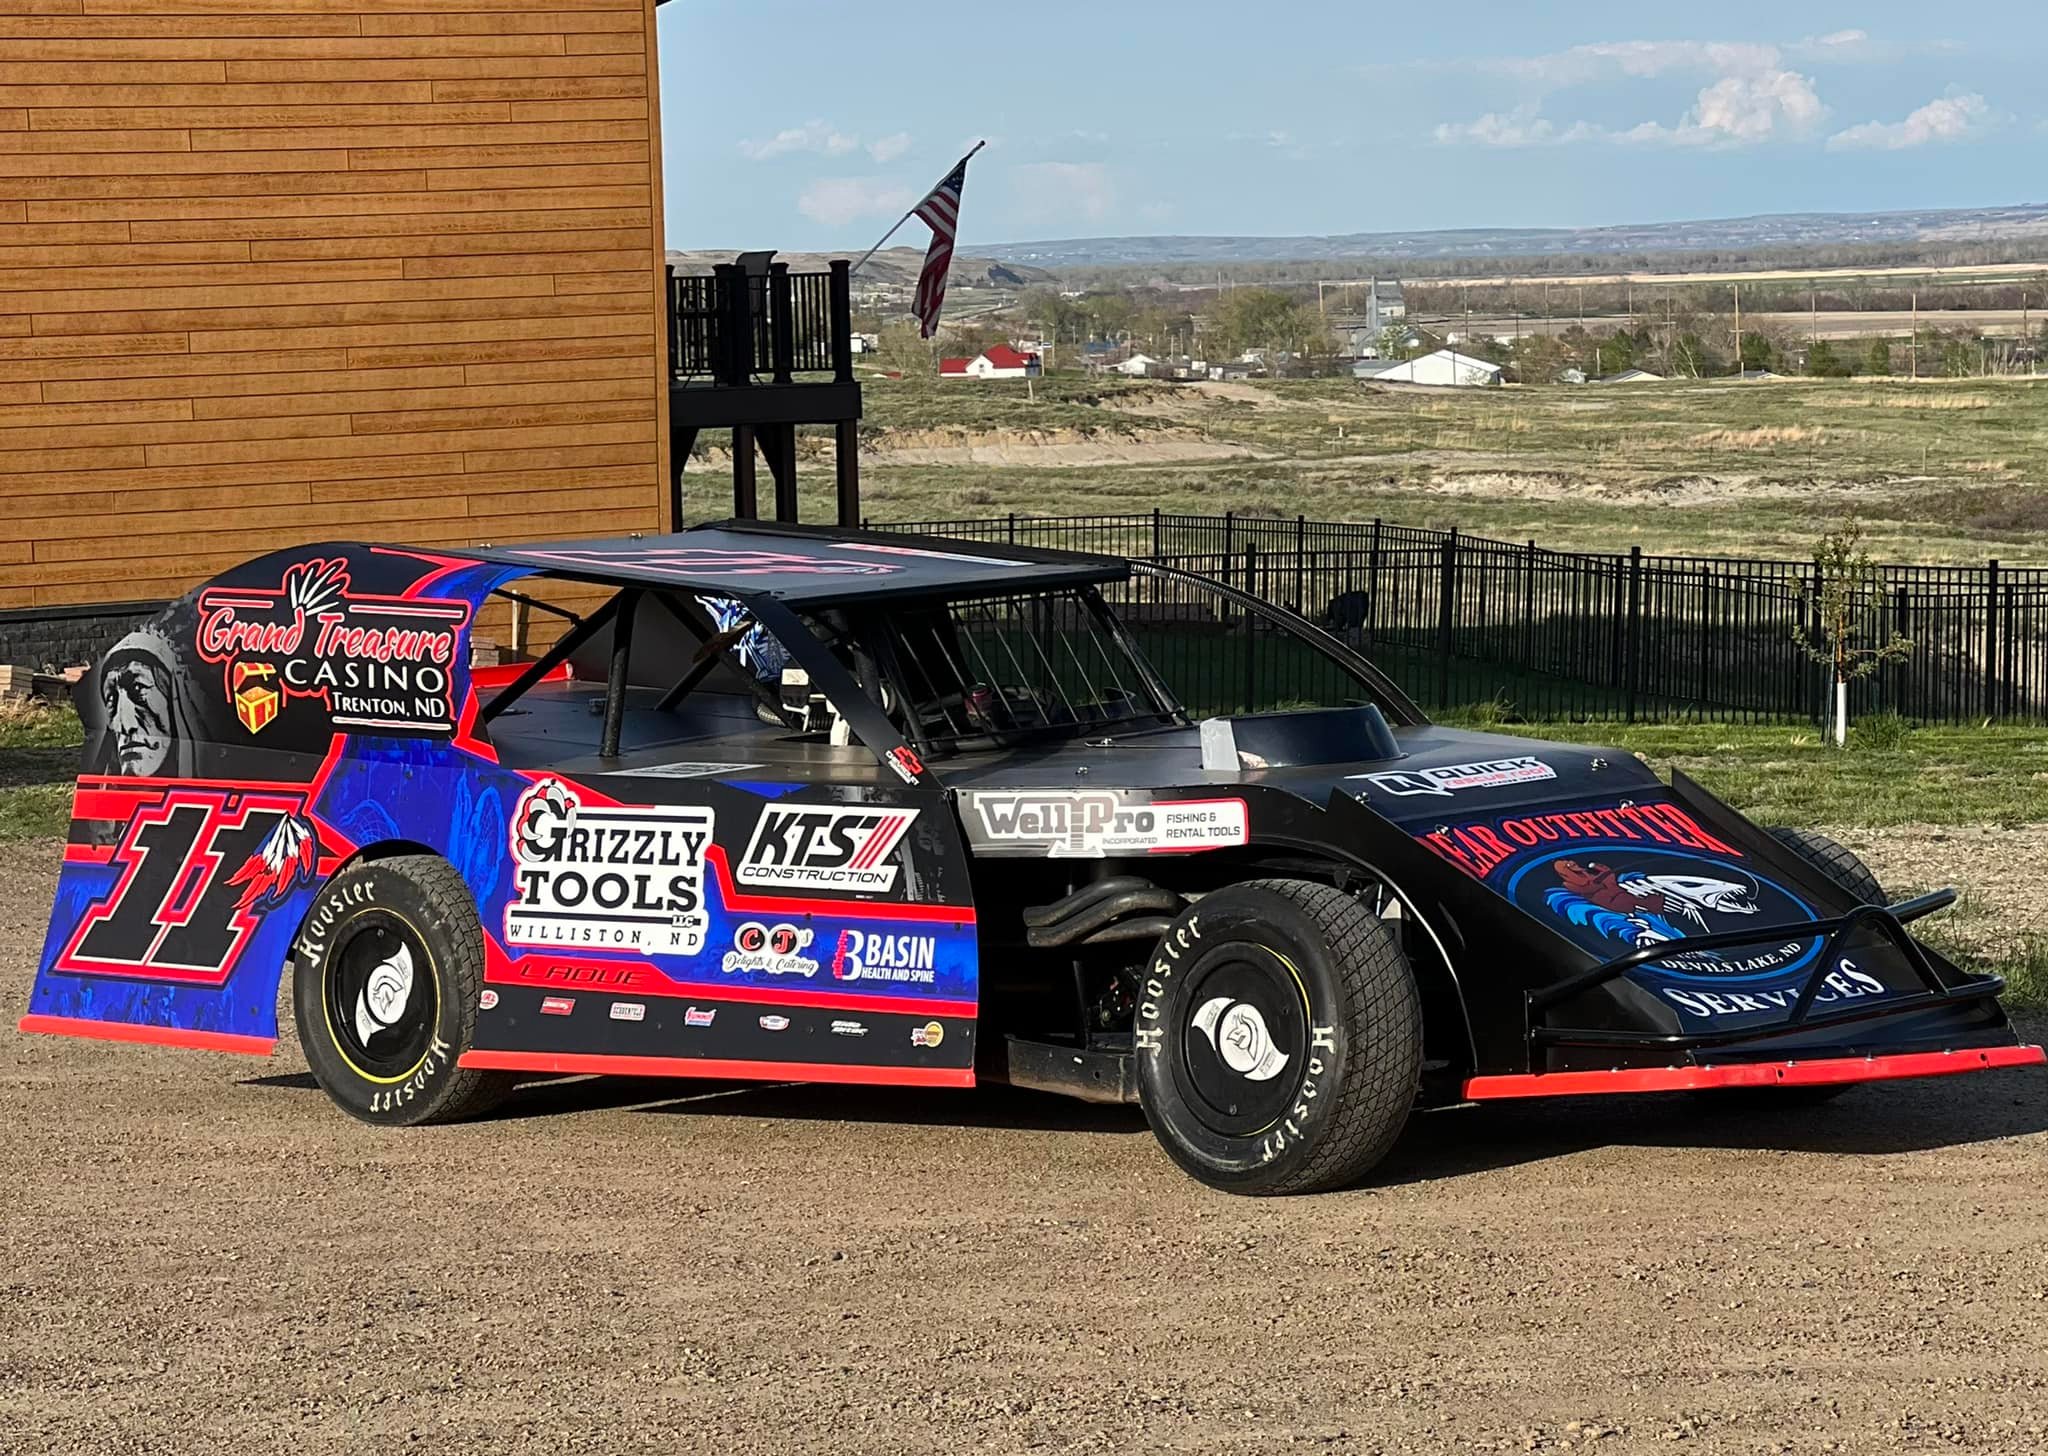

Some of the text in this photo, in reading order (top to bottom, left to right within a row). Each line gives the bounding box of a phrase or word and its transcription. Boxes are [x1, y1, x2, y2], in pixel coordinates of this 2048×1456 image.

[203, 606, 450, 663] Grand Treasure
[285, 659, 444, 693] CASINO
[415, 698, 446, 718] ND
[1430, 759, 1538, 779] QUICK
[519, 798, 706, 867] GRIZZLY
[1166, 812, 1216, 824] FISHING &
[1166, 826, 1241, 838] RENTAL TOOLS
[1502, 803, 1744, 858] OUTFITTER
[1102, 837, 1158, 845] INCORPORATED
[62, 797, 292, 977] 11
[521, 870, 698, 912] TOOLS
[742, 867, 889, 884] CONSTRUCTION
[292, 879, 375, 968] Hoosier
[672, 915, 695, 928] LLC
[670, 932, 698, 946] ND
[865, 933, 936, 969] BASIN
[726, 954, 763, 969] Delights
[775, 958, 815, 974] Catering
[1661, 942, 1802, 973] DEVILS LAKE, ND
[861, 967, 935, 984] HEALTH AND SPINE
[1135, 915, 1201, 1057] Hoosier
[1662, 958, 1886, 1017] SERVCES
[369, 1036, 451, 1113] Hoosier
[1261, 1025, 1336, 1163] Hoosier
